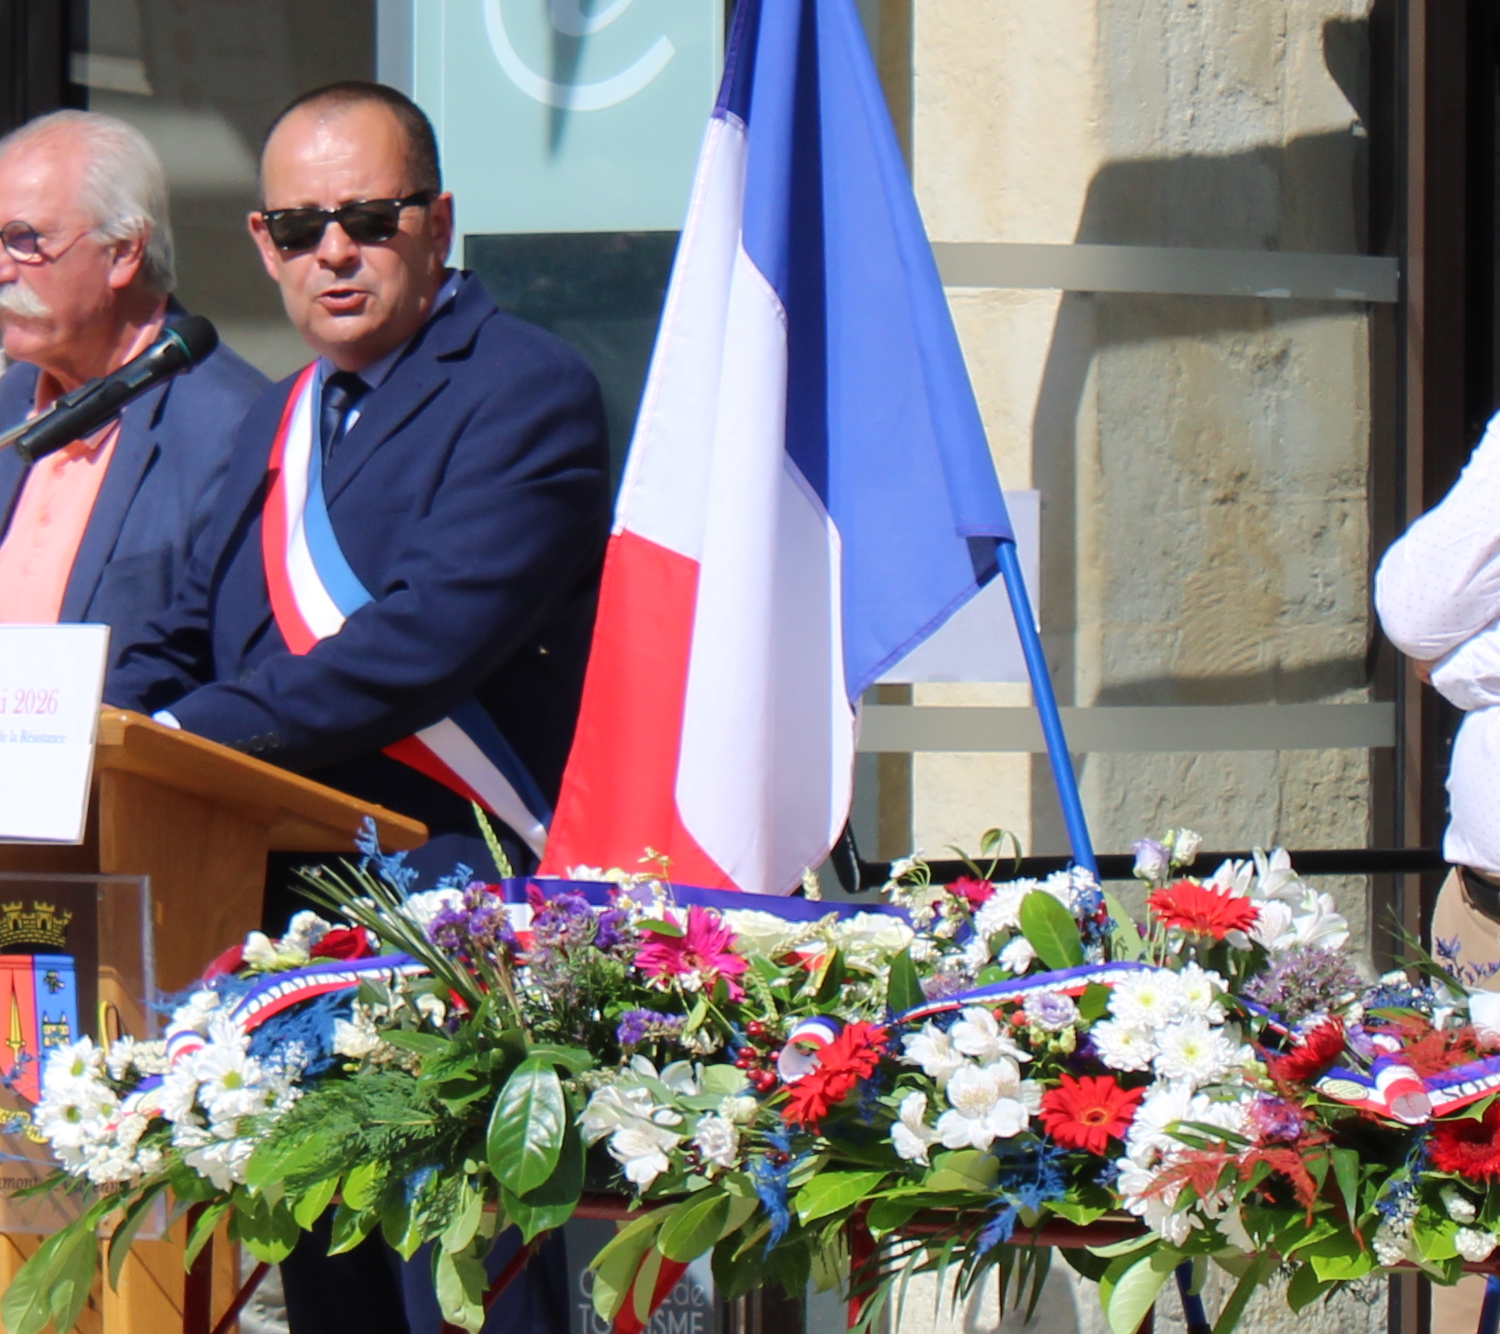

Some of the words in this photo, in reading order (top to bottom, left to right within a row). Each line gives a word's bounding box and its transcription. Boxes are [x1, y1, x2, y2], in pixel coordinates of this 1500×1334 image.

[11, 688, 60, 715] 2026
[9, 729, 17, 742] la
[19, 729, 67, 744] Résistance
